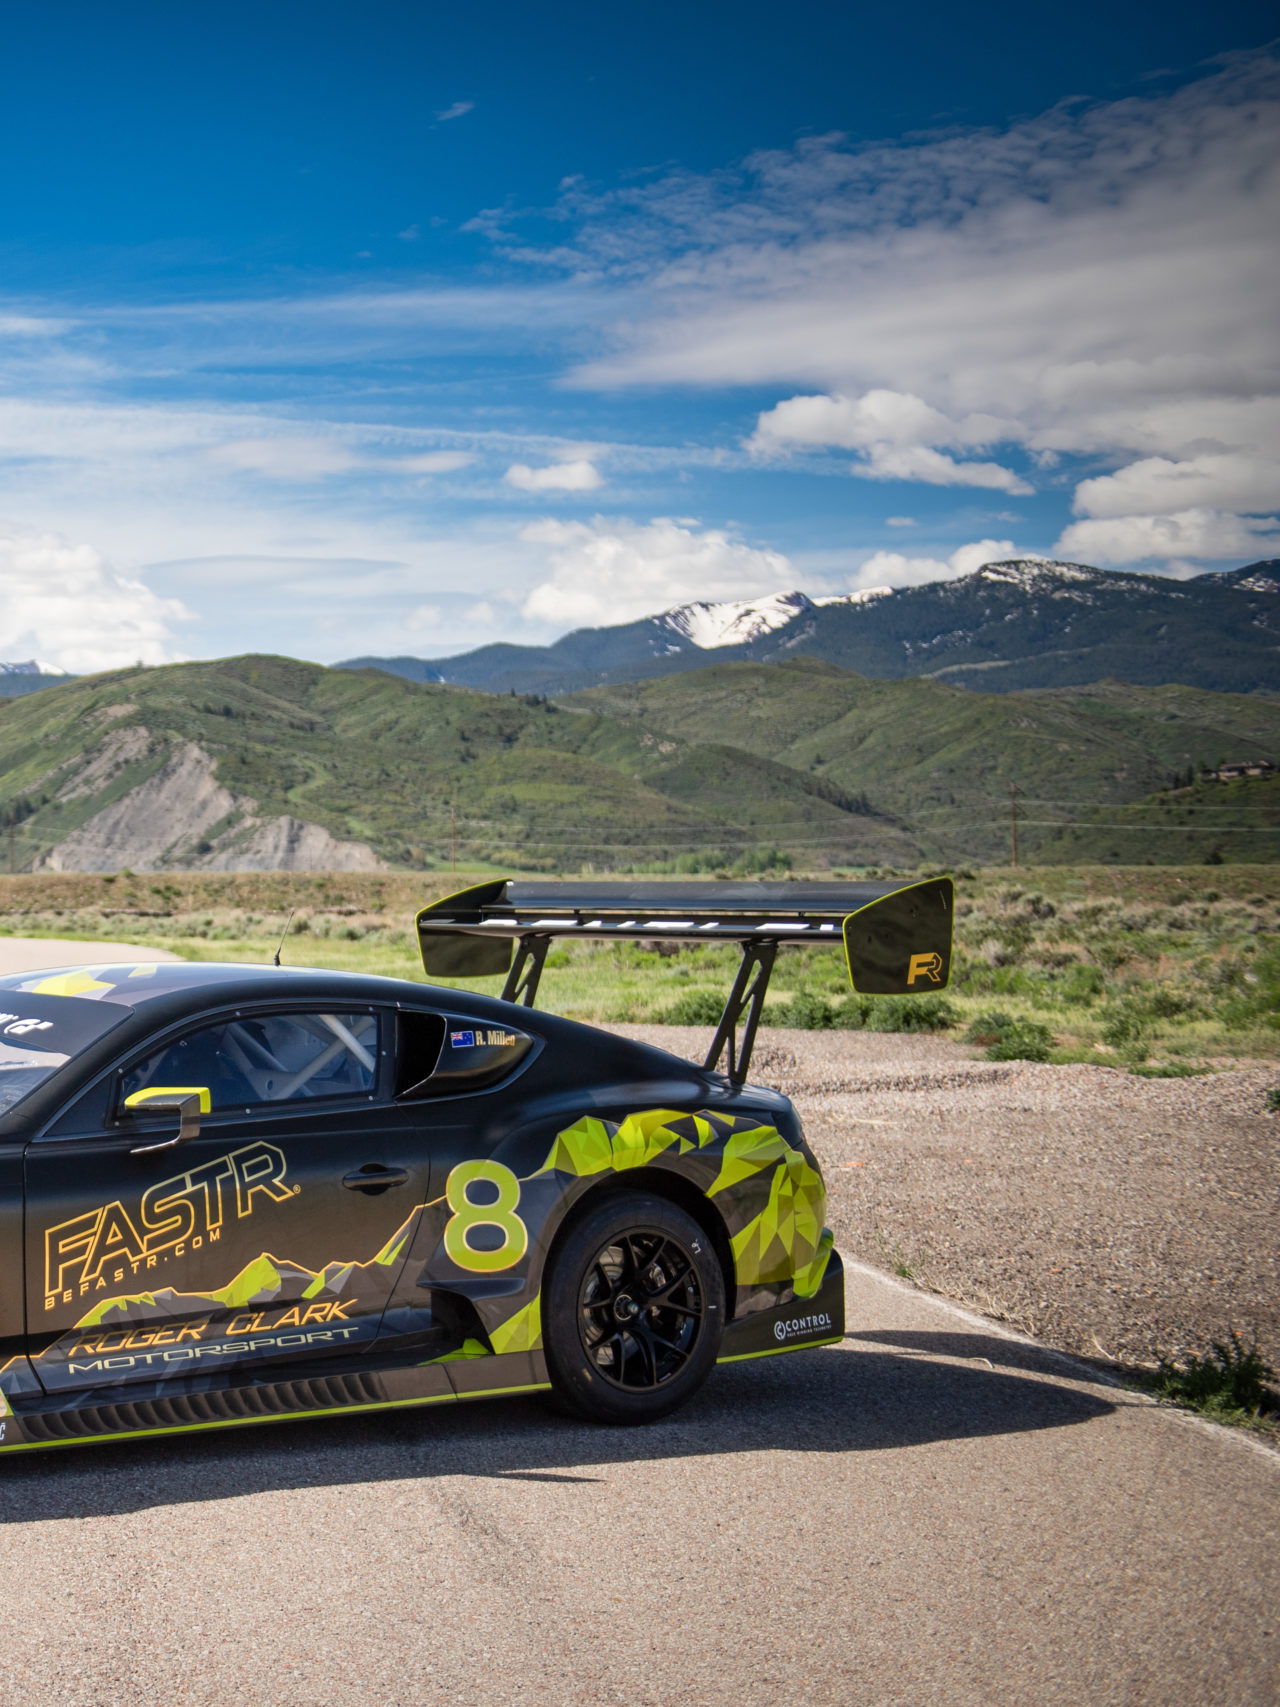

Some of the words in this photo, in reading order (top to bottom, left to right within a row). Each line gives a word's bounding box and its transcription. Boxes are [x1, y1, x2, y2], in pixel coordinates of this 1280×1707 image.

[45, 1141, 295, 1297] FASTR
[444, 1159, 528, 1272] 8
[45, 1229, 220, 1310] BEFASTR.COM
[68, 1319, 210, 1357] ROGER
[226, 1298, 358, 1336] CLARK
[68, 1326, 359, 1374] MOTORSPORT
[785, 1313, 831, 1331] CONTROL
